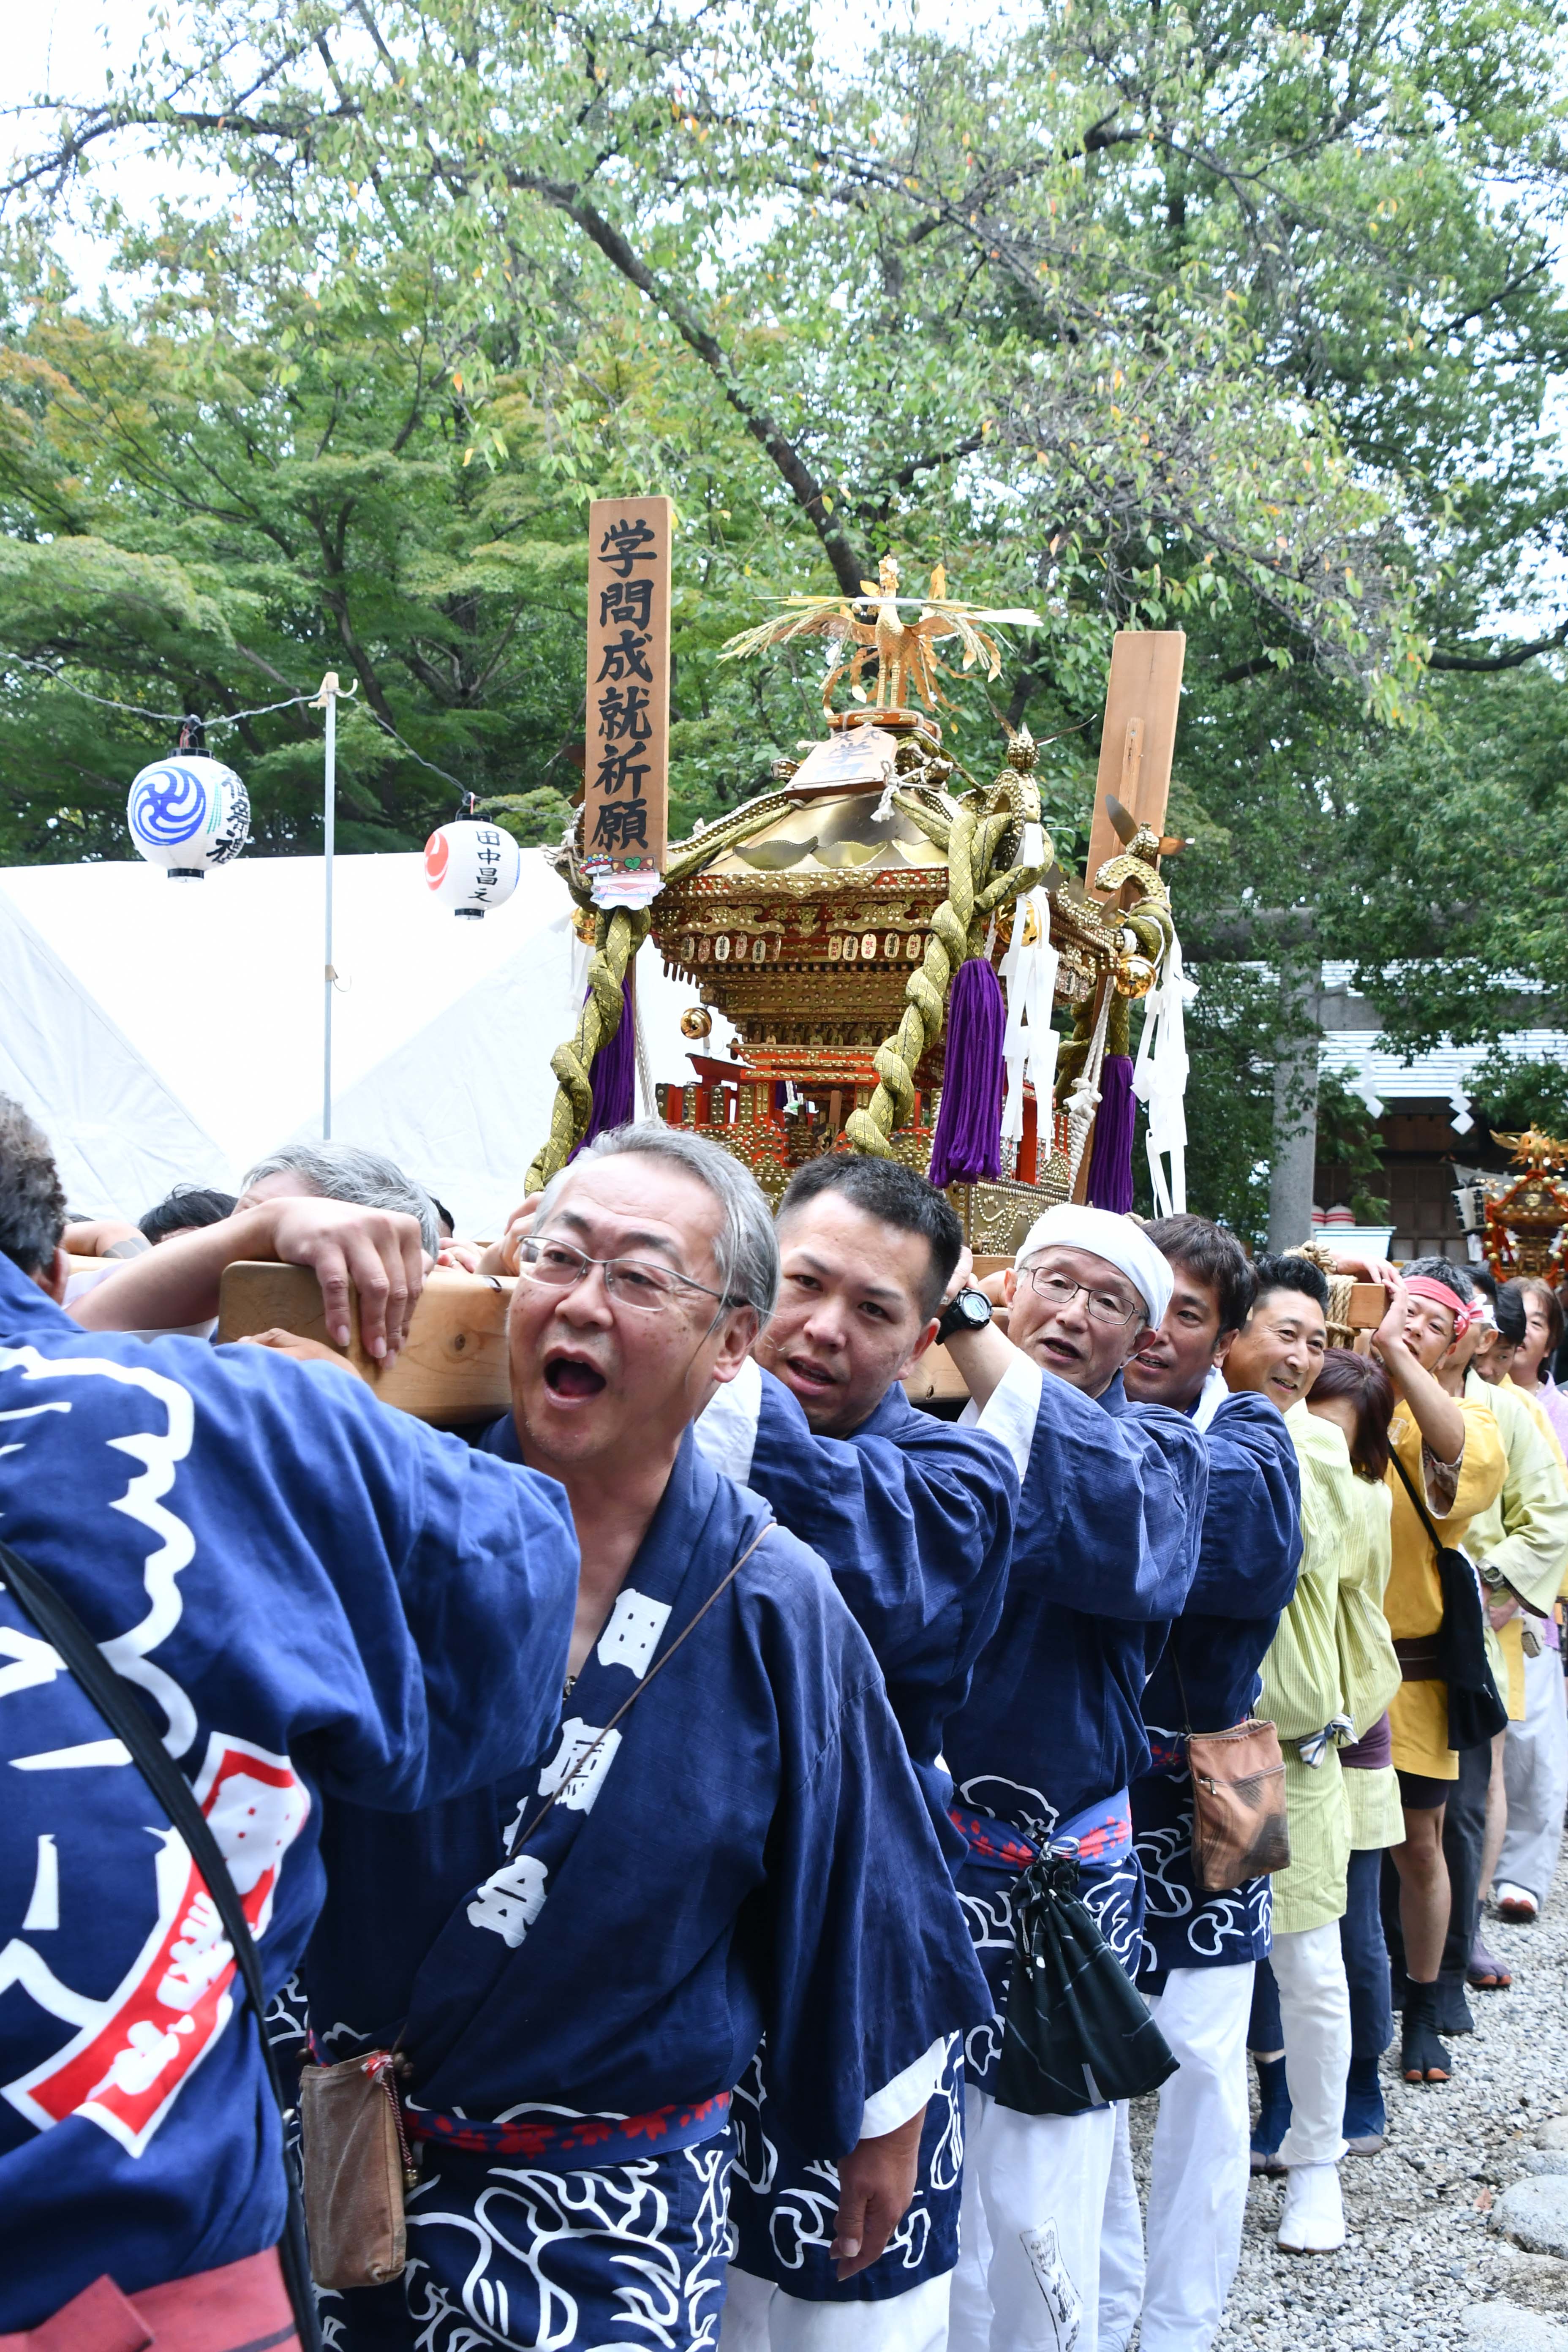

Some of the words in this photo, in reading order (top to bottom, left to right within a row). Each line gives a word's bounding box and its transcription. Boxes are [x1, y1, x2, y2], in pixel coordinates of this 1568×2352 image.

[590, 519, 657, 852] 学問成就祈願
[468, 831, 501, 902] 田中昌之
